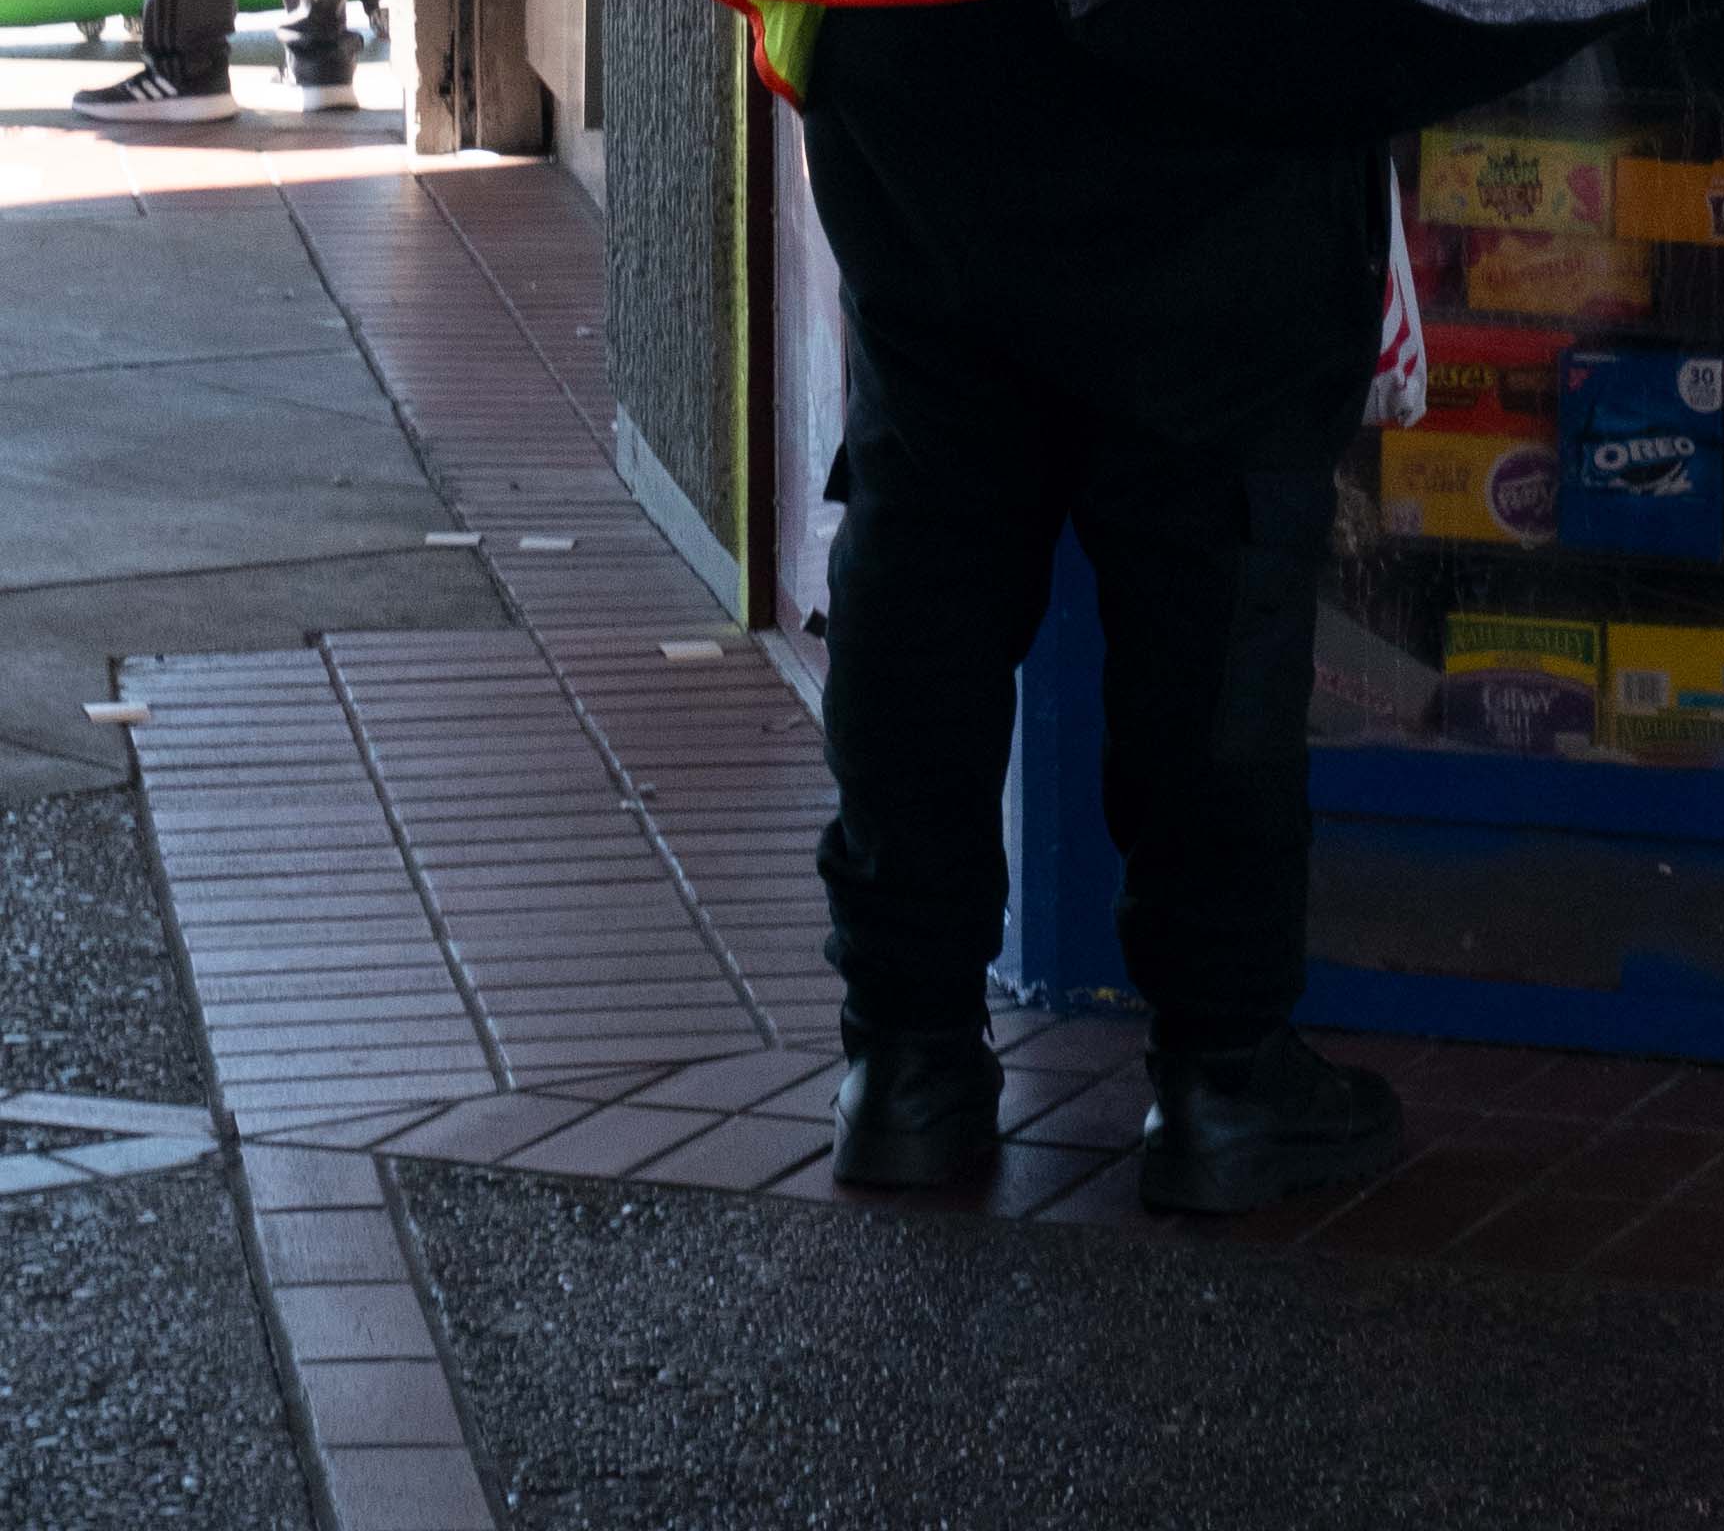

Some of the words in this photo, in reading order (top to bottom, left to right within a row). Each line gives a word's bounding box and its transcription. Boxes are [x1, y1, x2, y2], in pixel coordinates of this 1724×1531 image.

[1689, 368, 1713, 386] 30
[1593, 435, 1696, 471] OREO
[1482, 682, 1552, 715] CHEWY
